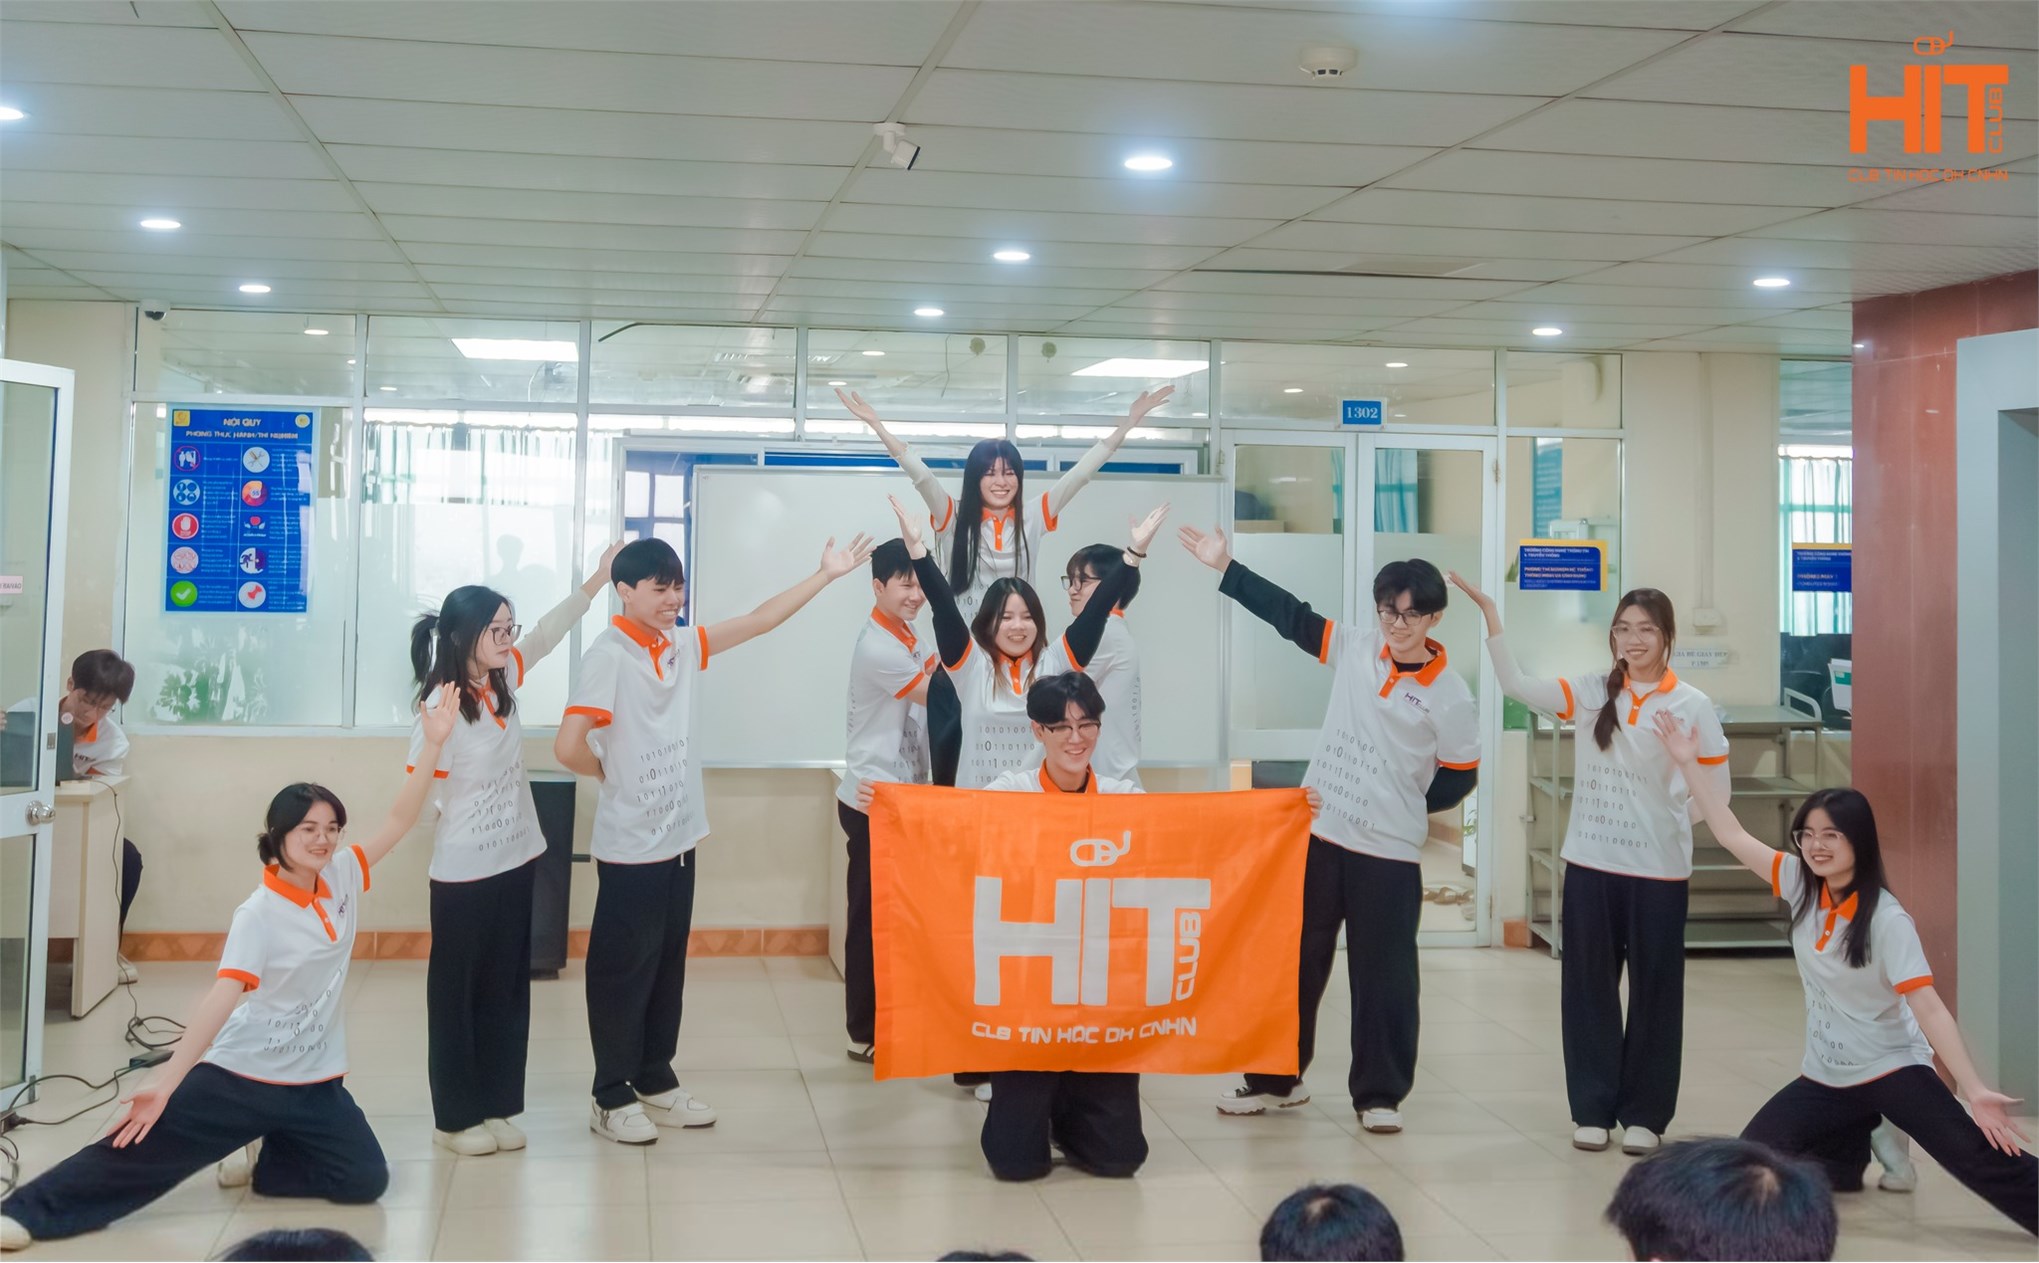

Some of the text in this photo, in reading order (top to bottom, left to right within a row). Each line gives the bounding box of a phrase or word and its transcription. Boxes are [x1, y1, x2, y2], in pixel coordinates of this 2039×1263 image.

[1347, 407, 1378, 419] 1302
[1404, 692, 1422, 706] HIT
[973, 876, 1211, 1006] HIT
[1176, 911, 1201, 1001] CLUB
[971, 1021, 1012, 1041] CLB
[1018, 1026, 1052, 1044] TIN
[1139, 1016, 1197, 1039] CNHN
